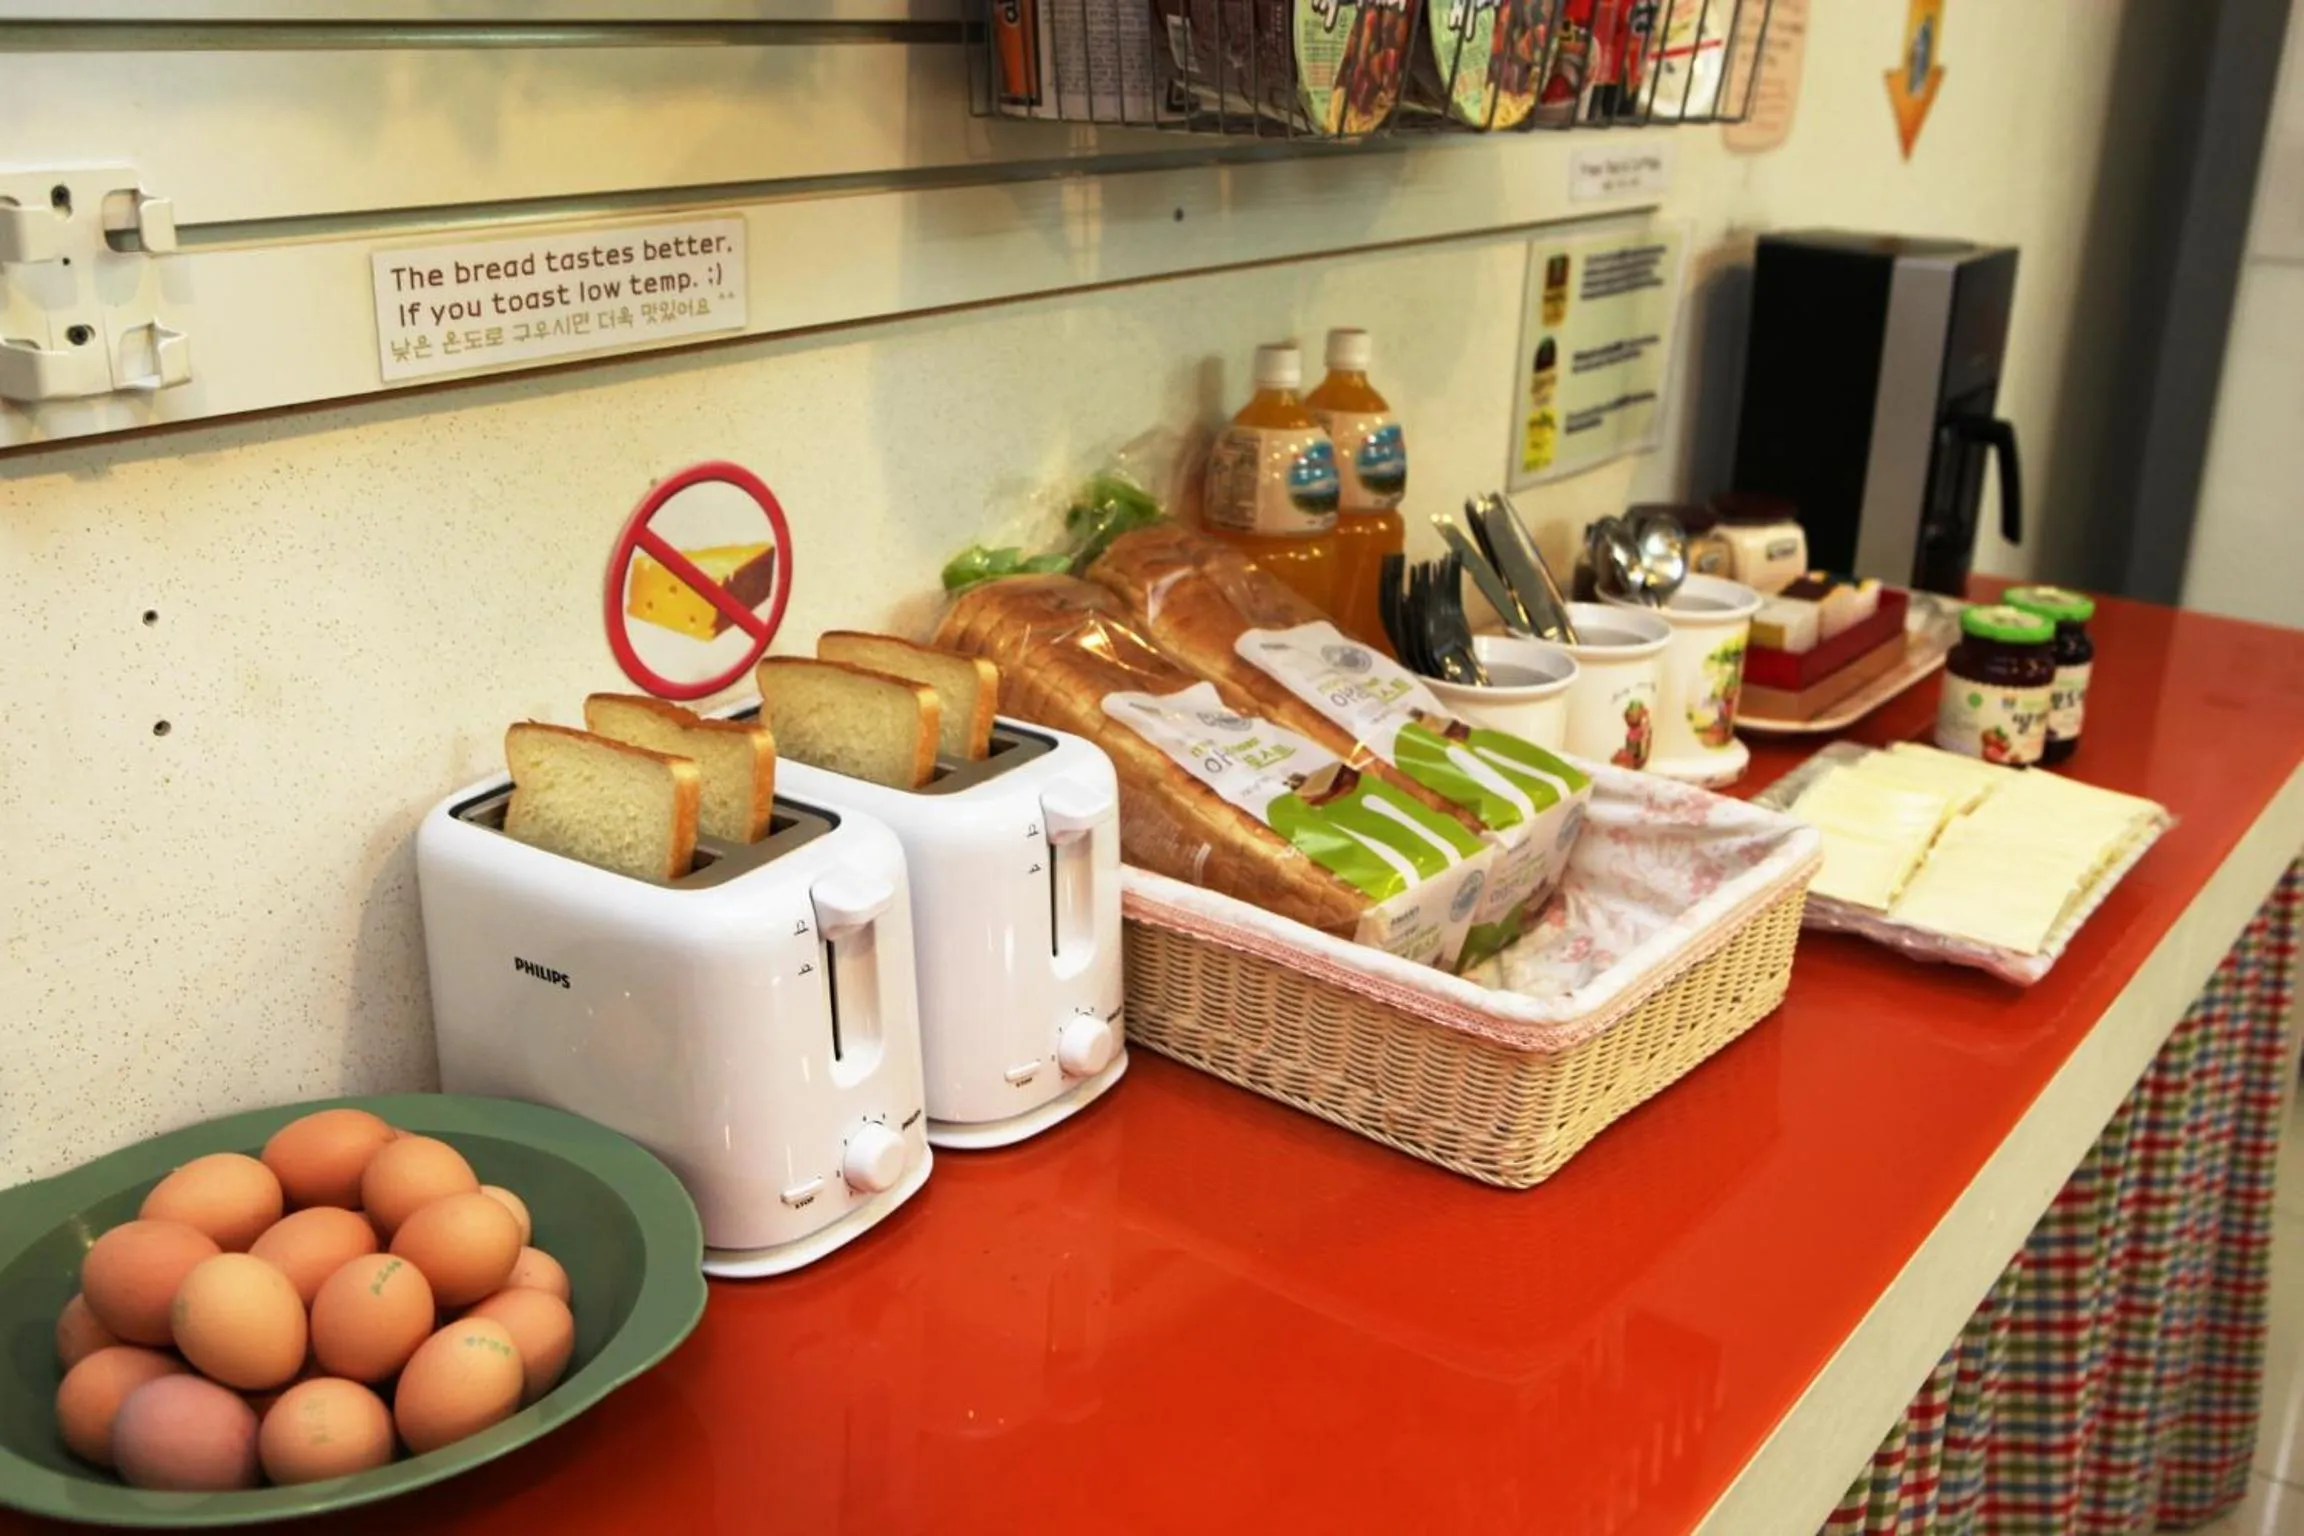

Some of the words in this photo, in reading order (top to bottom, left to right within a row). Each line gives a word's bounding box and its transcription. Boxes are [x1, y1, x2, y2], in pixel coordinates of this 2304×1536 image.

[391, 266, 444, 292] The
[454, 252, 536, 285] bread
[545, 245, 635, 273] tastes
[643, 234, 733, 262] better.
[399, 302, 422, 328] If
[431, 300, 482, 327] you
[491, 283, 571, 315] toast
[580, 280, 622, 302] low
[629, 271, 698, 296] temp.
[390, 335, 433, 363] 낮은
[442, 326, 504, 355] 온도로
[512, 311, 591, 342] 구우시면
[598, 305, 634, 330] 더욱
[641, 297, 711, 326] 맛있어요
[514, 956, 571, 989] PHILIPS
